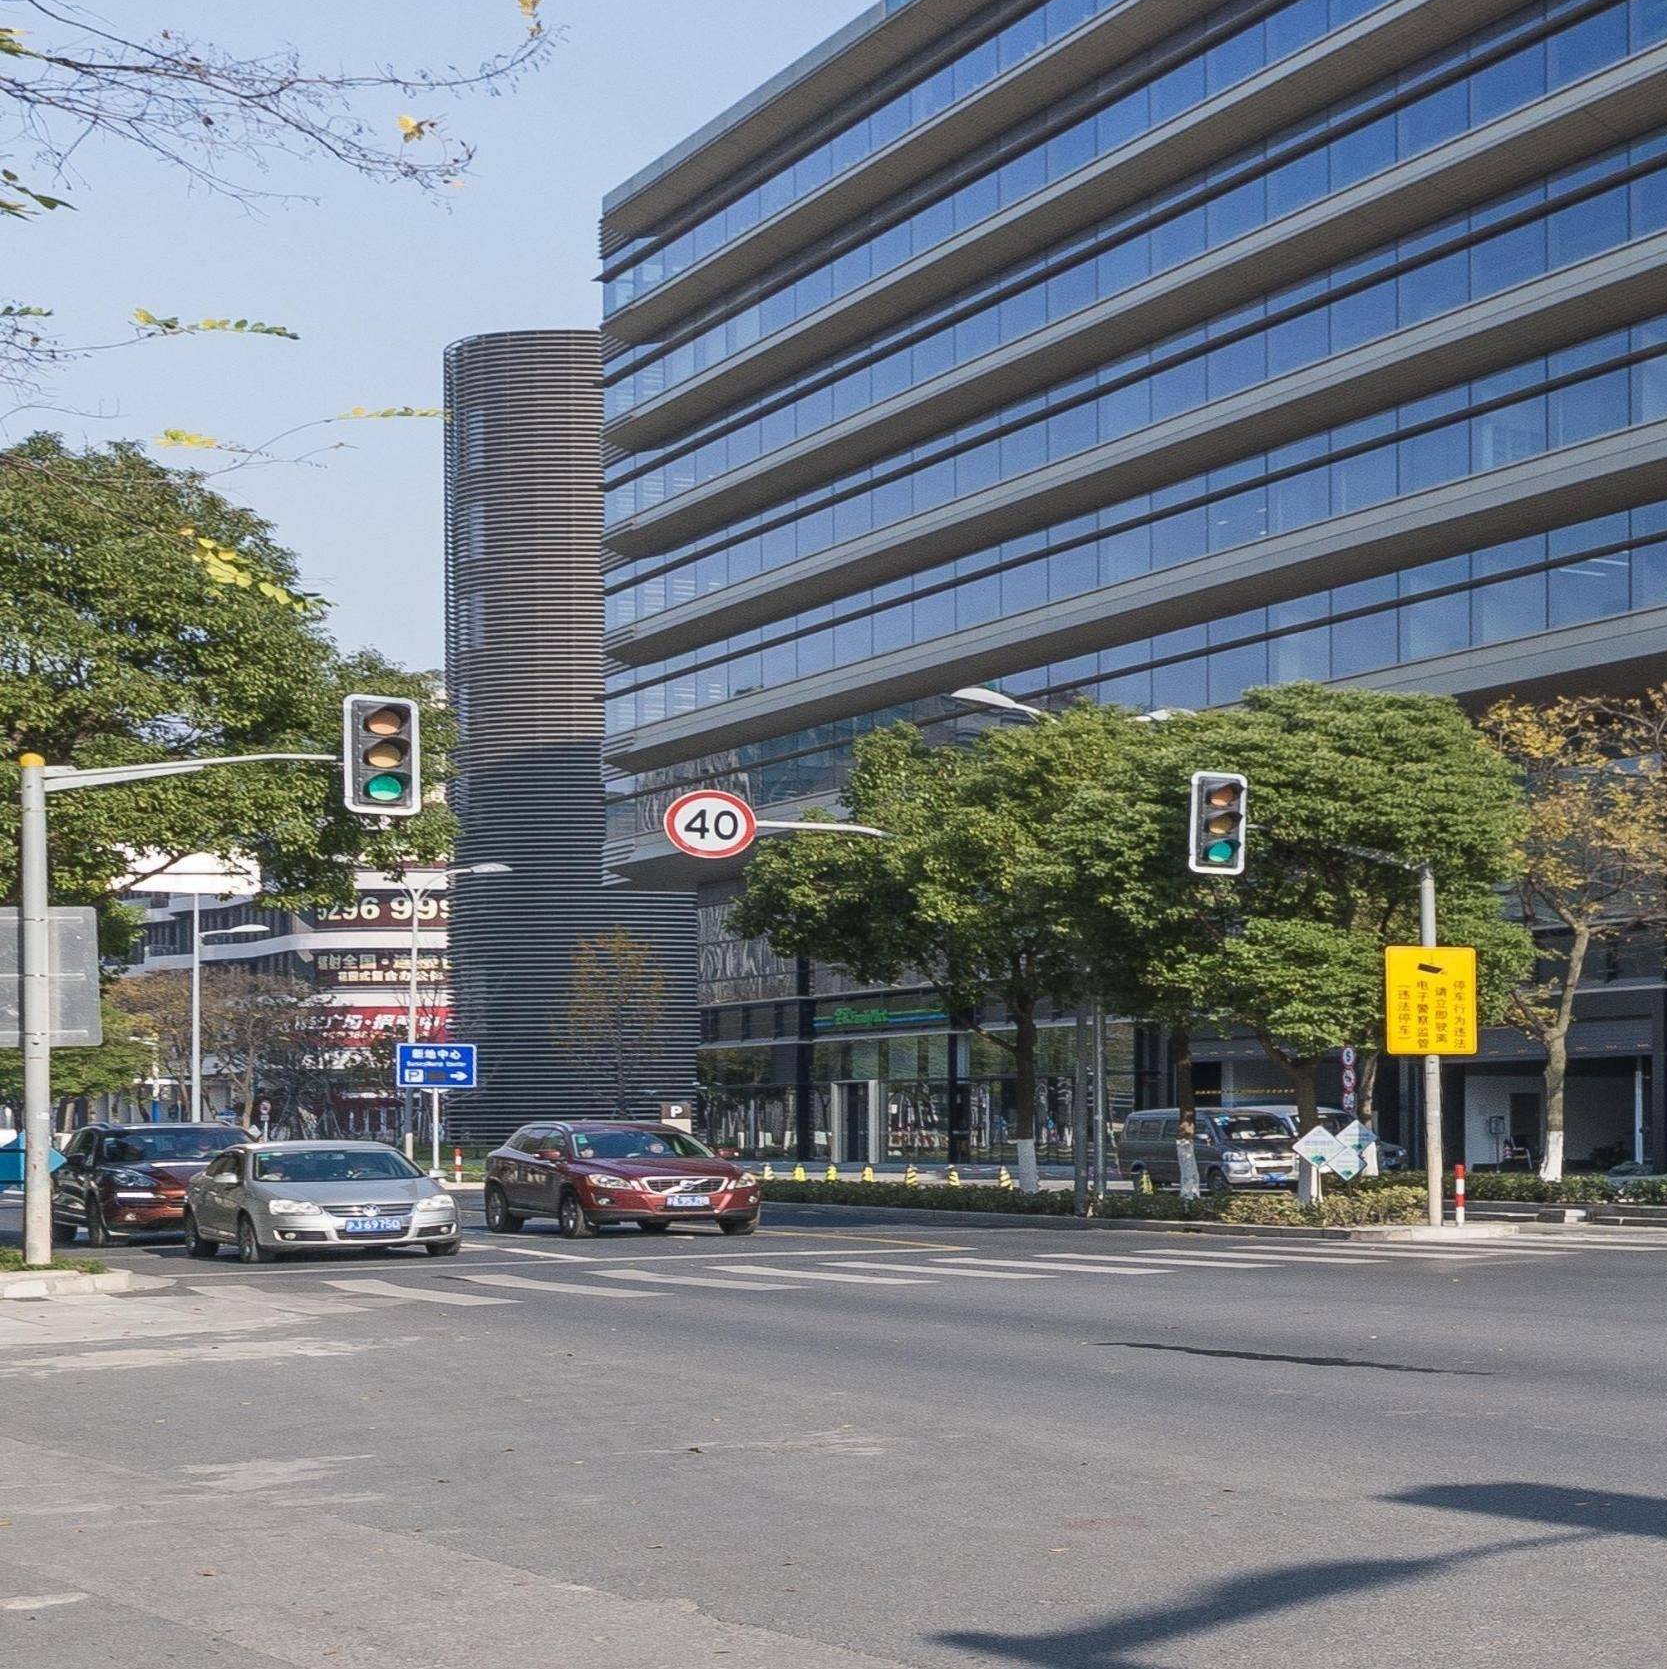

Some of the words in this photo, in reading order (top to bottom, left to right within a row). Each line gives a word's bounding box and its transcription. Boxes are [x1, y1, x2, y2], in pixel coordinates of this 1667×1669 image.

[684, 809, 739, 841] 40
[1453, 980, 1466, 1049] 停车行为违法
[411, 1048, 462, 1060] 新地中心
[670, 1105, 683, 1118] P
